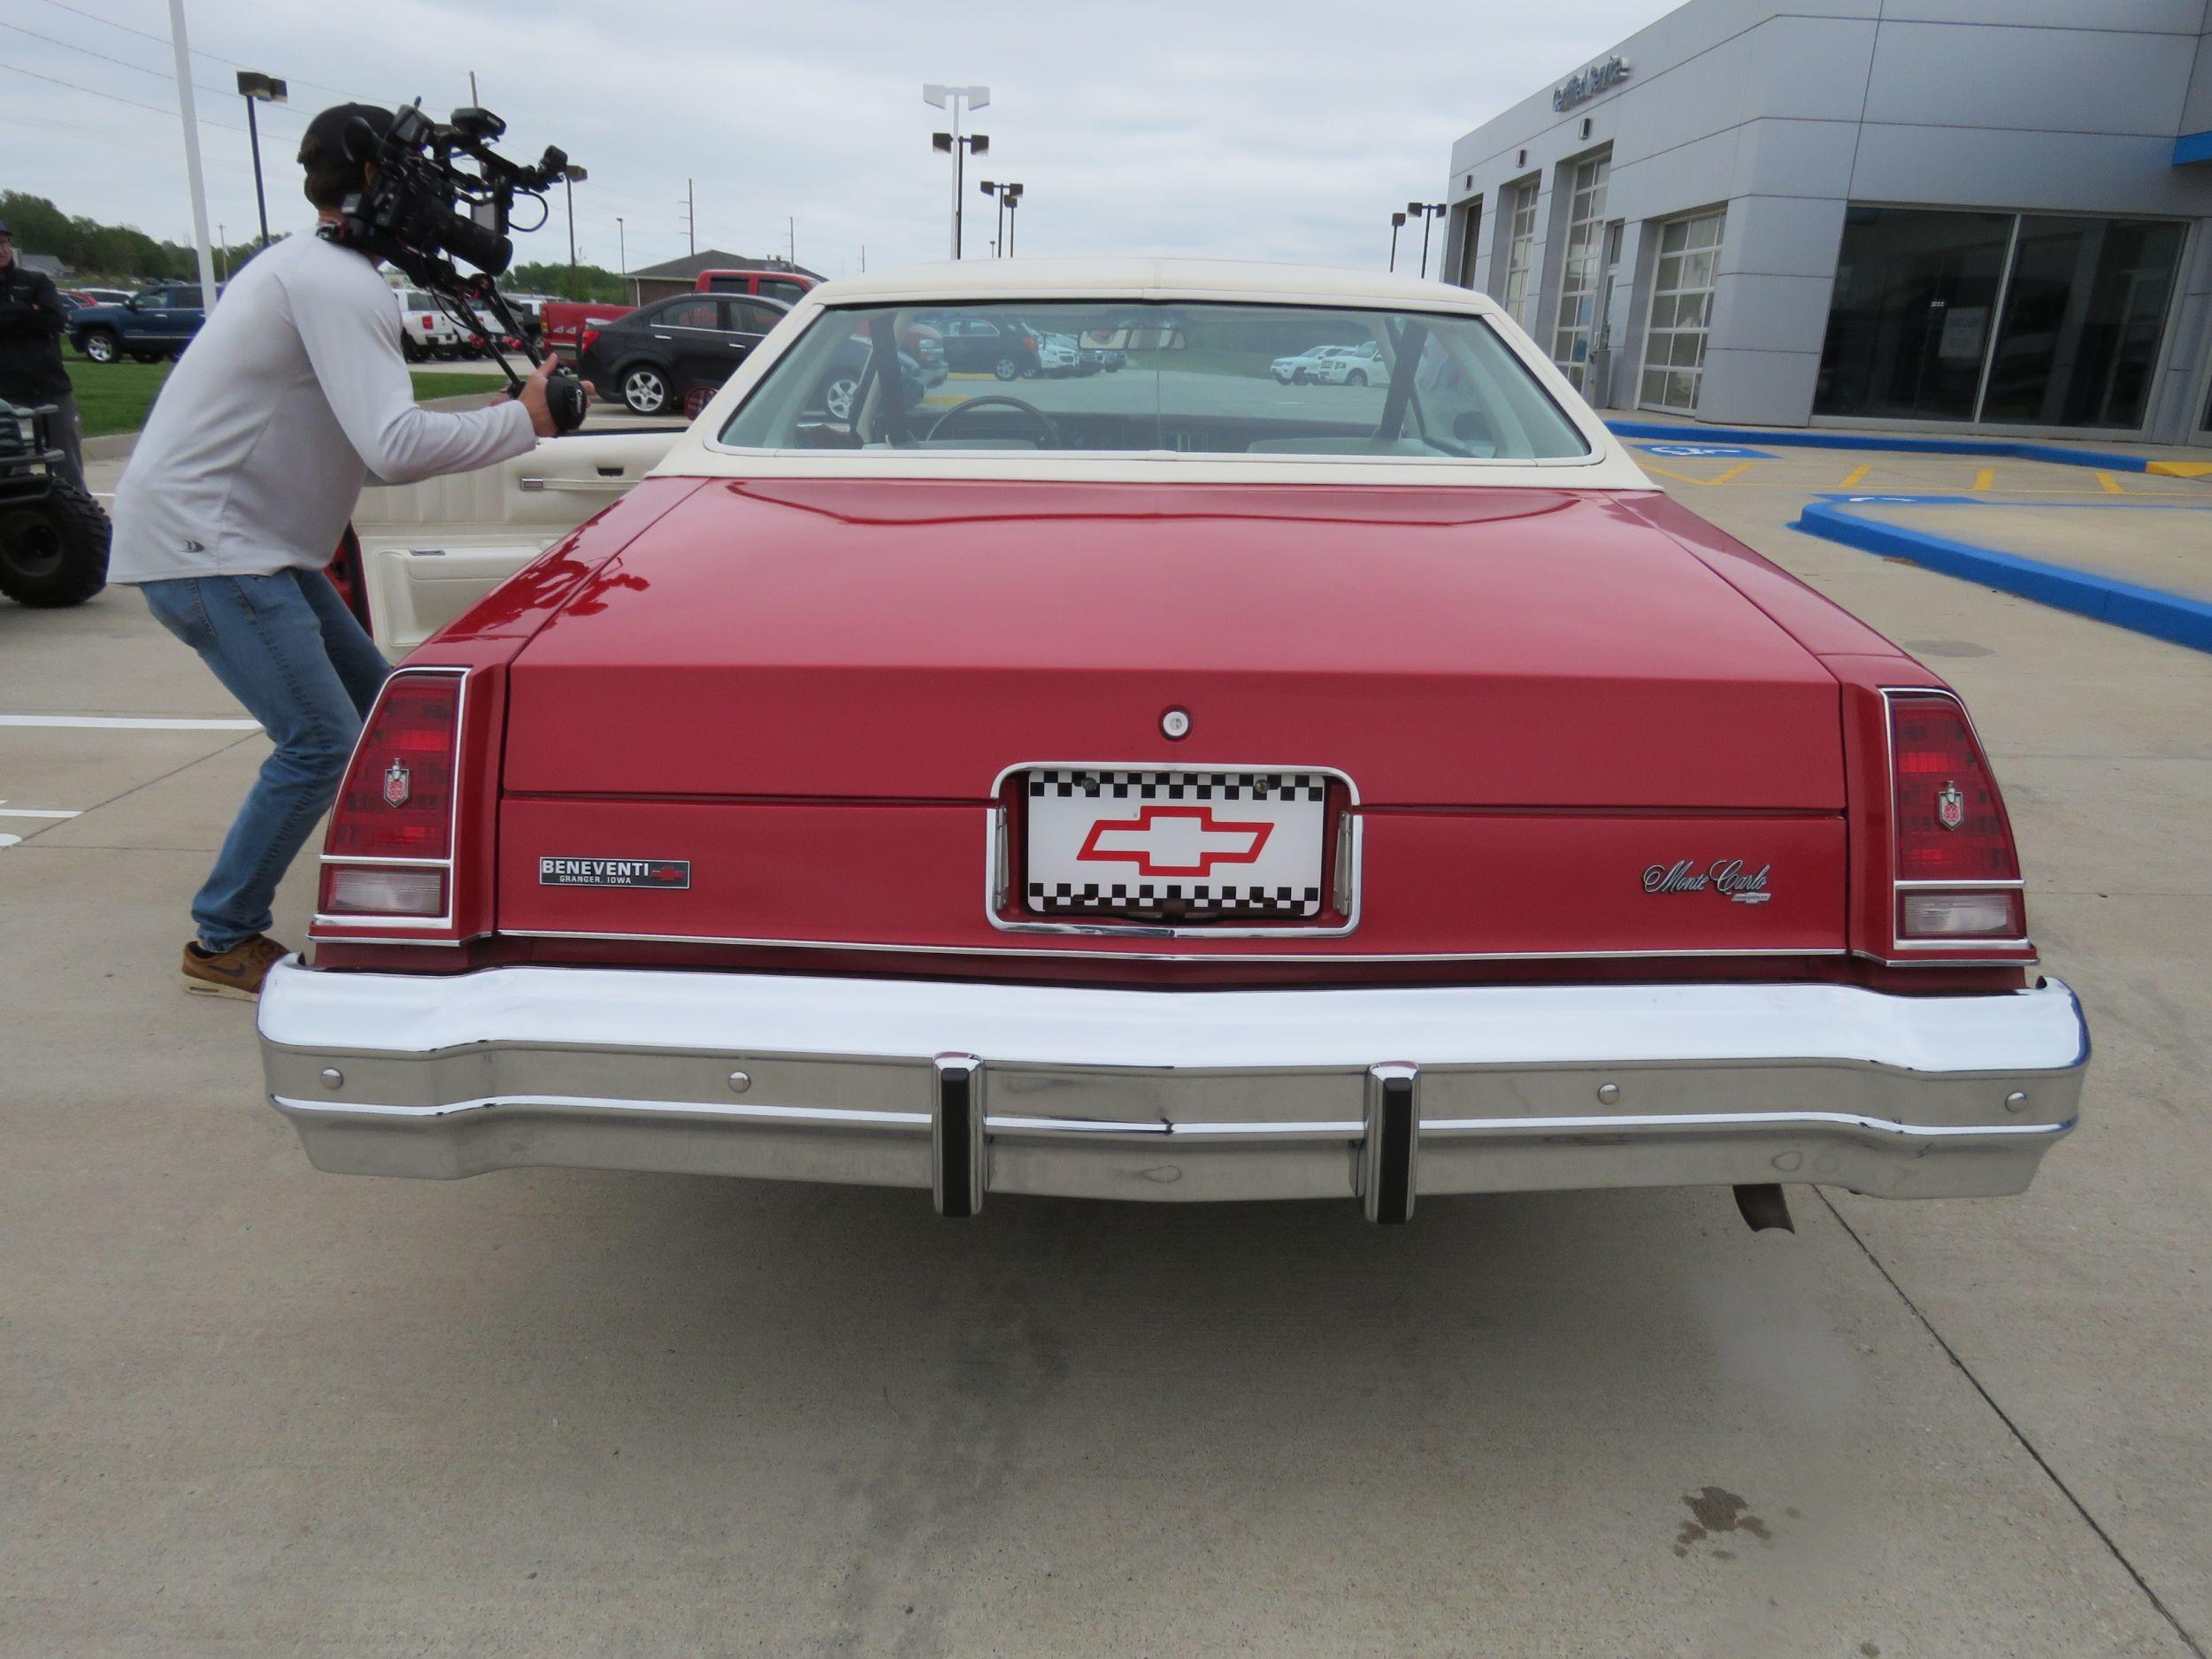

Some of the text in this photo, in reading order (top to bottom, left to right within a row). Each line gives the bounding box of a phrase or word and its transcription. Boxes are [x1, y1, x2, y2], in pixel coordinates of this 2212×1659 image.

[542, 860, 649, 876] BENEVENTI
[607, 876, 632, 885] IOWA
[1643, 859, 1770, 895] Monte Carlo
